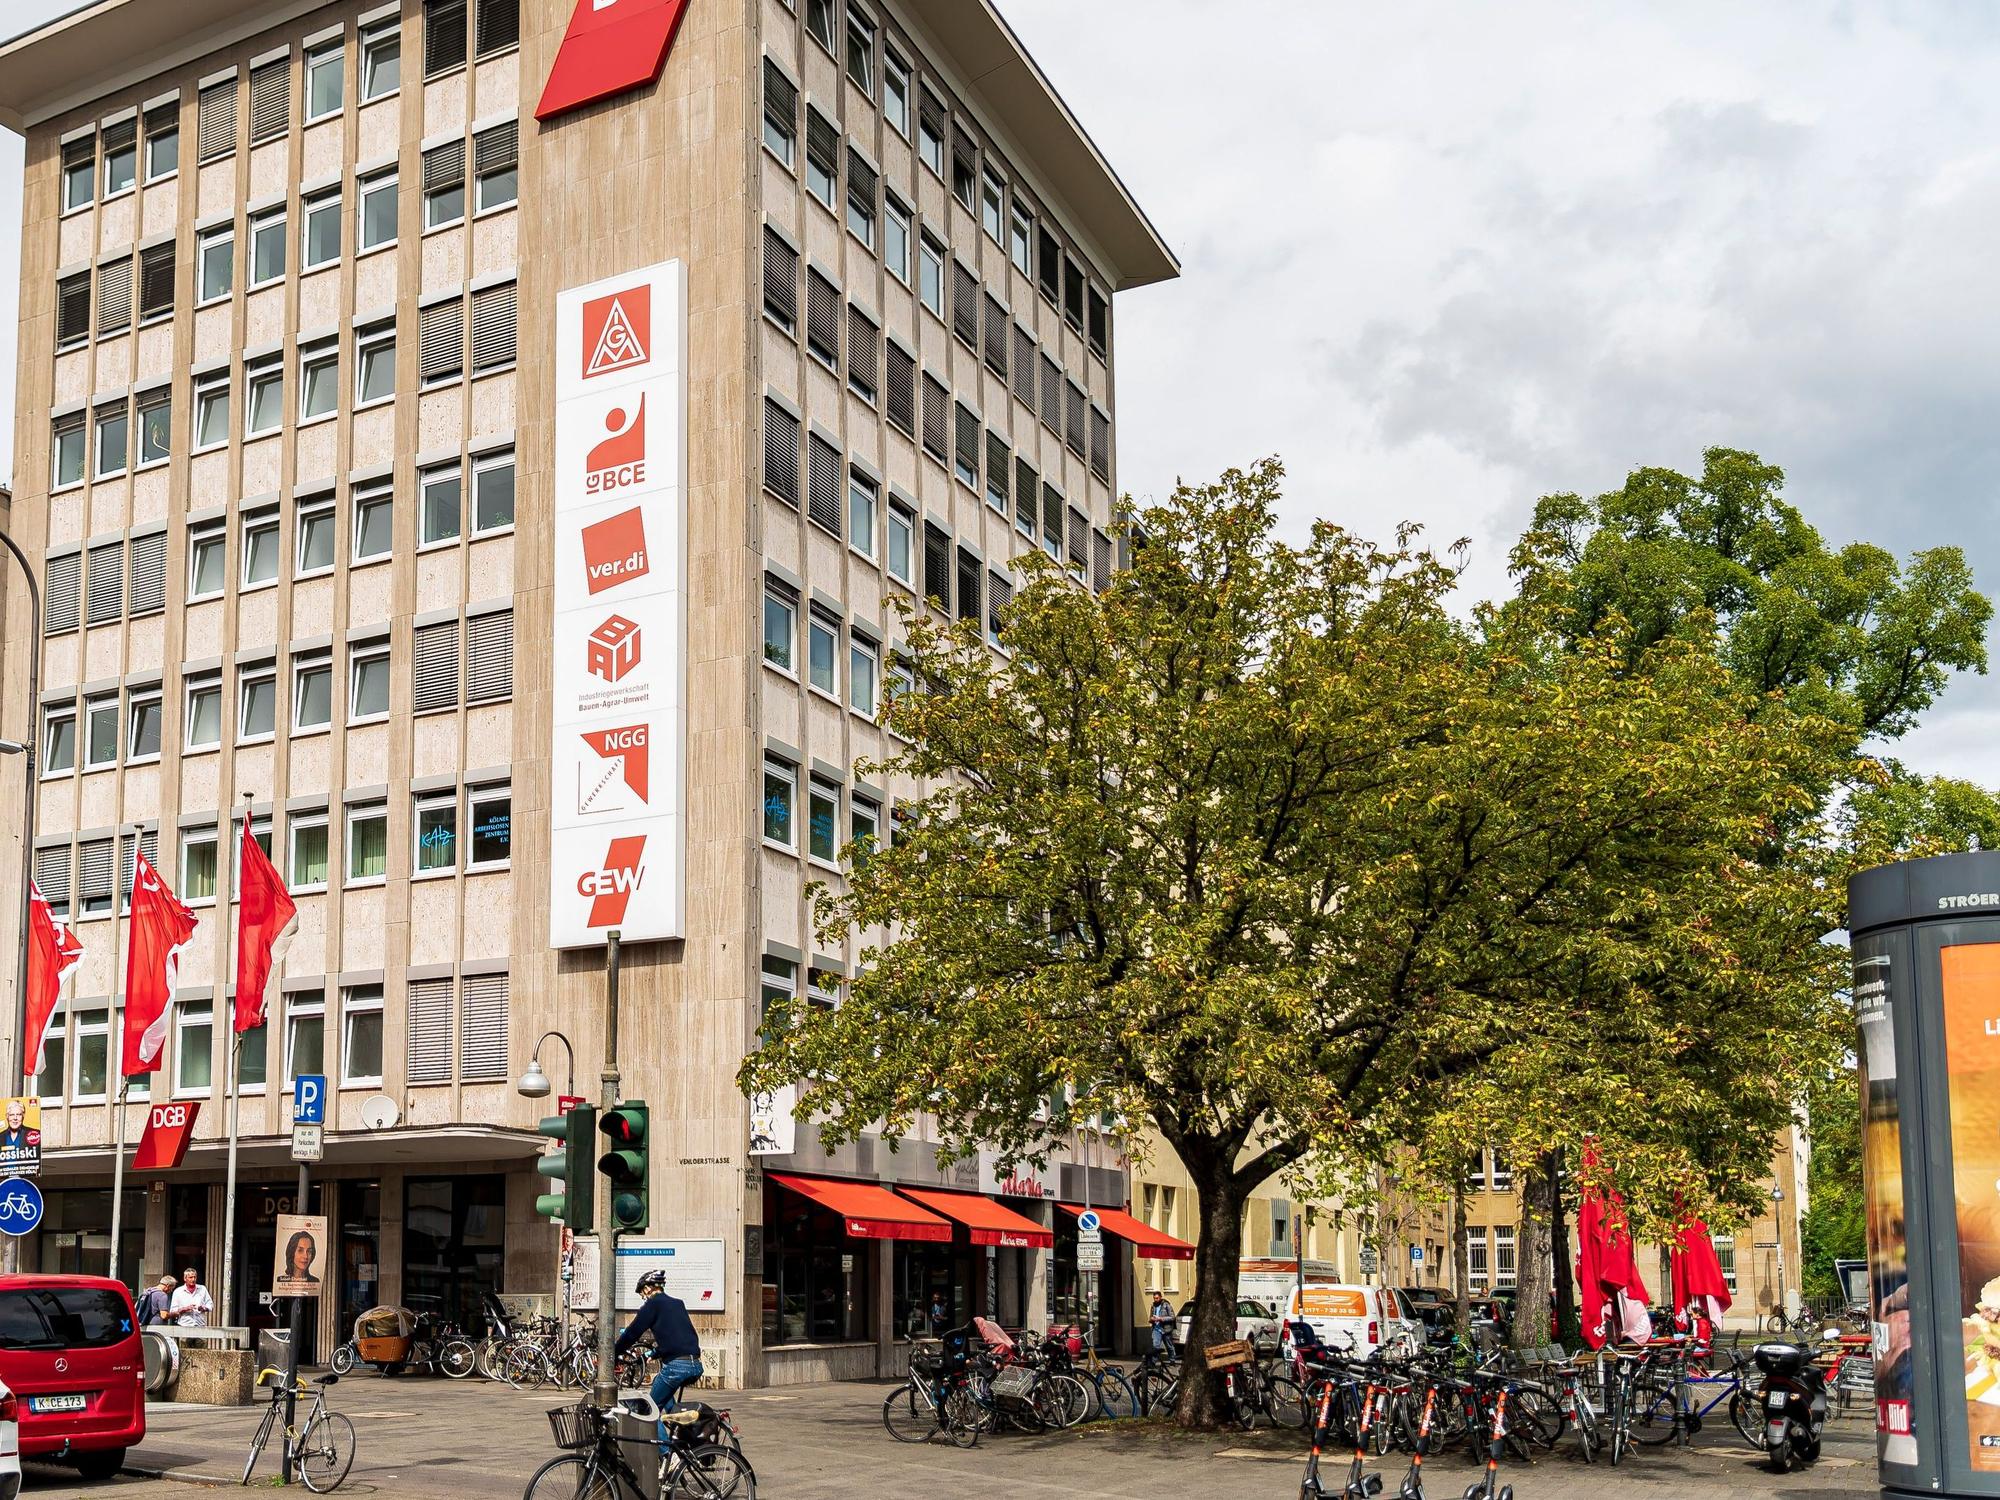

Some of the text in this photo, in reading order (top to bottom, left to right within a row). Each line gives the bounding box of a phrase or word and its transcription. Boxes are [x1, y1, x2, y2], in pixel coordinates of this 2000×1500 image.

[602, 463, 646, 492] BCE
[588, 550, 645, 580] ver.di
[578, 682, 650, 702] Industriegewerkschaft
[578, 692, 650, 712] Bauen-Agrar-Umwelt
[604, 727, 646, 752] NGG
[580, 758, 623, 812] GEWERKSCHAFT
[488, 815, 510, 824] KÖLNER
[484, 830, 510, 839] ZENTRUM
[576, 864, 646, 898] GEW
[1938, 893, 2000, 909] STRÖER
[301, 1081, 318, 1117] P
[152, 1105, 186, 1129] DGB
[38, 1396, 82, 1408] K CE 173
[1888, 1403, 1908, 1432] Bild
